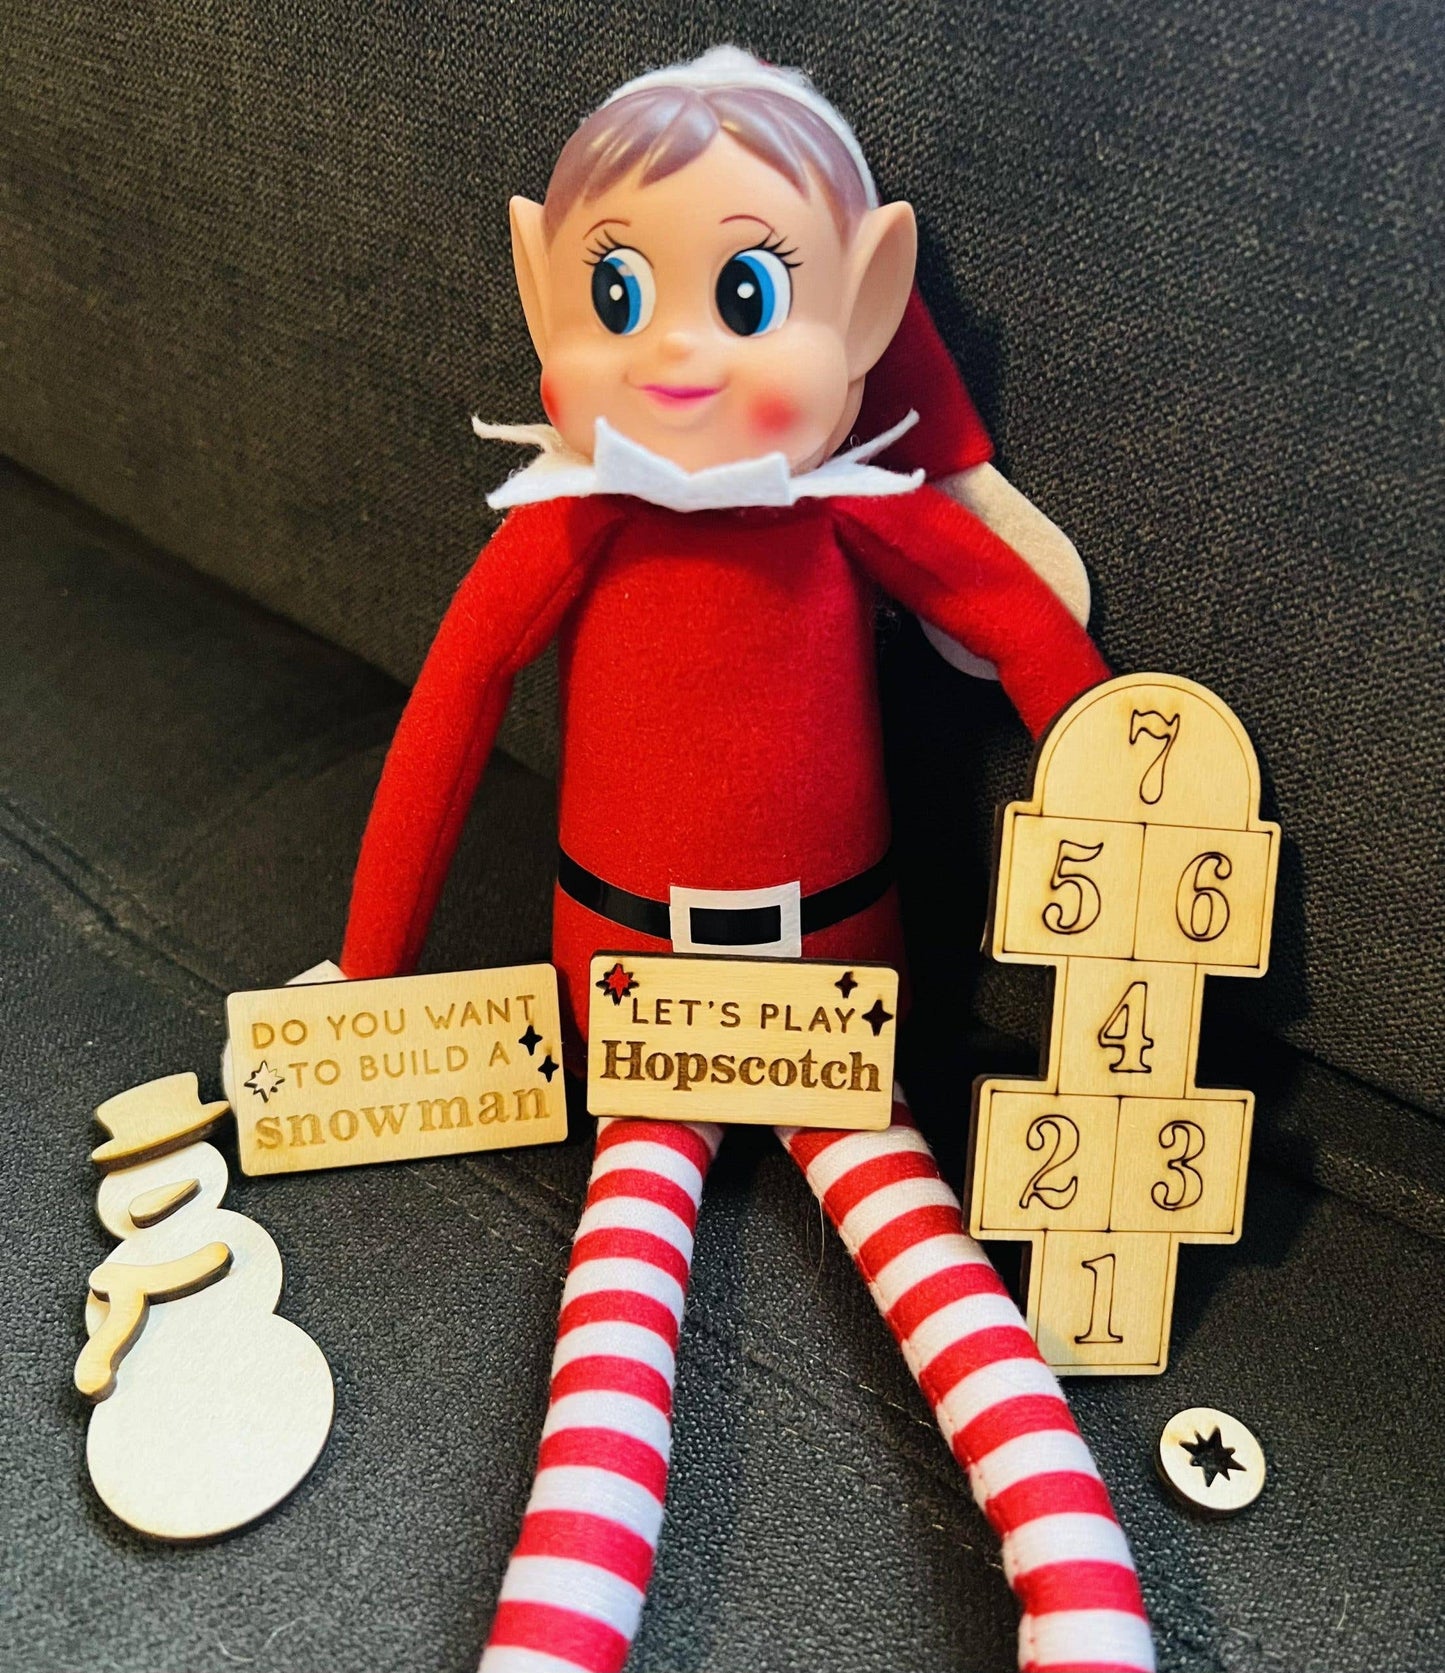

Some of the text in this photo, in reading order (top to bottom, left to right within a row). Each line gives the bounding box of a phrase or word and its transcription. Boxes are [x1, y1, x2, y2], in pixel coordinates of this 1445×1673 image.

[1129, 709, 1180, 805] 7
[1042, 839, 1232, 942] 5 6
[252, 994, 536, 1049] DO YOU WANT
[632, 998, 855, 1033] LET'S PLAY
[1098, 981, 1154, 1073] 4
[288, 1041, 511, 1088] TO BUILD A
[600, 1039, 881, 1092] Hopscotch
[255, 1087, 550, 1150] snowman
[1019, 1114, 1205, 1211] 2 3
[1074, 1253, 1123, 1344] 1
